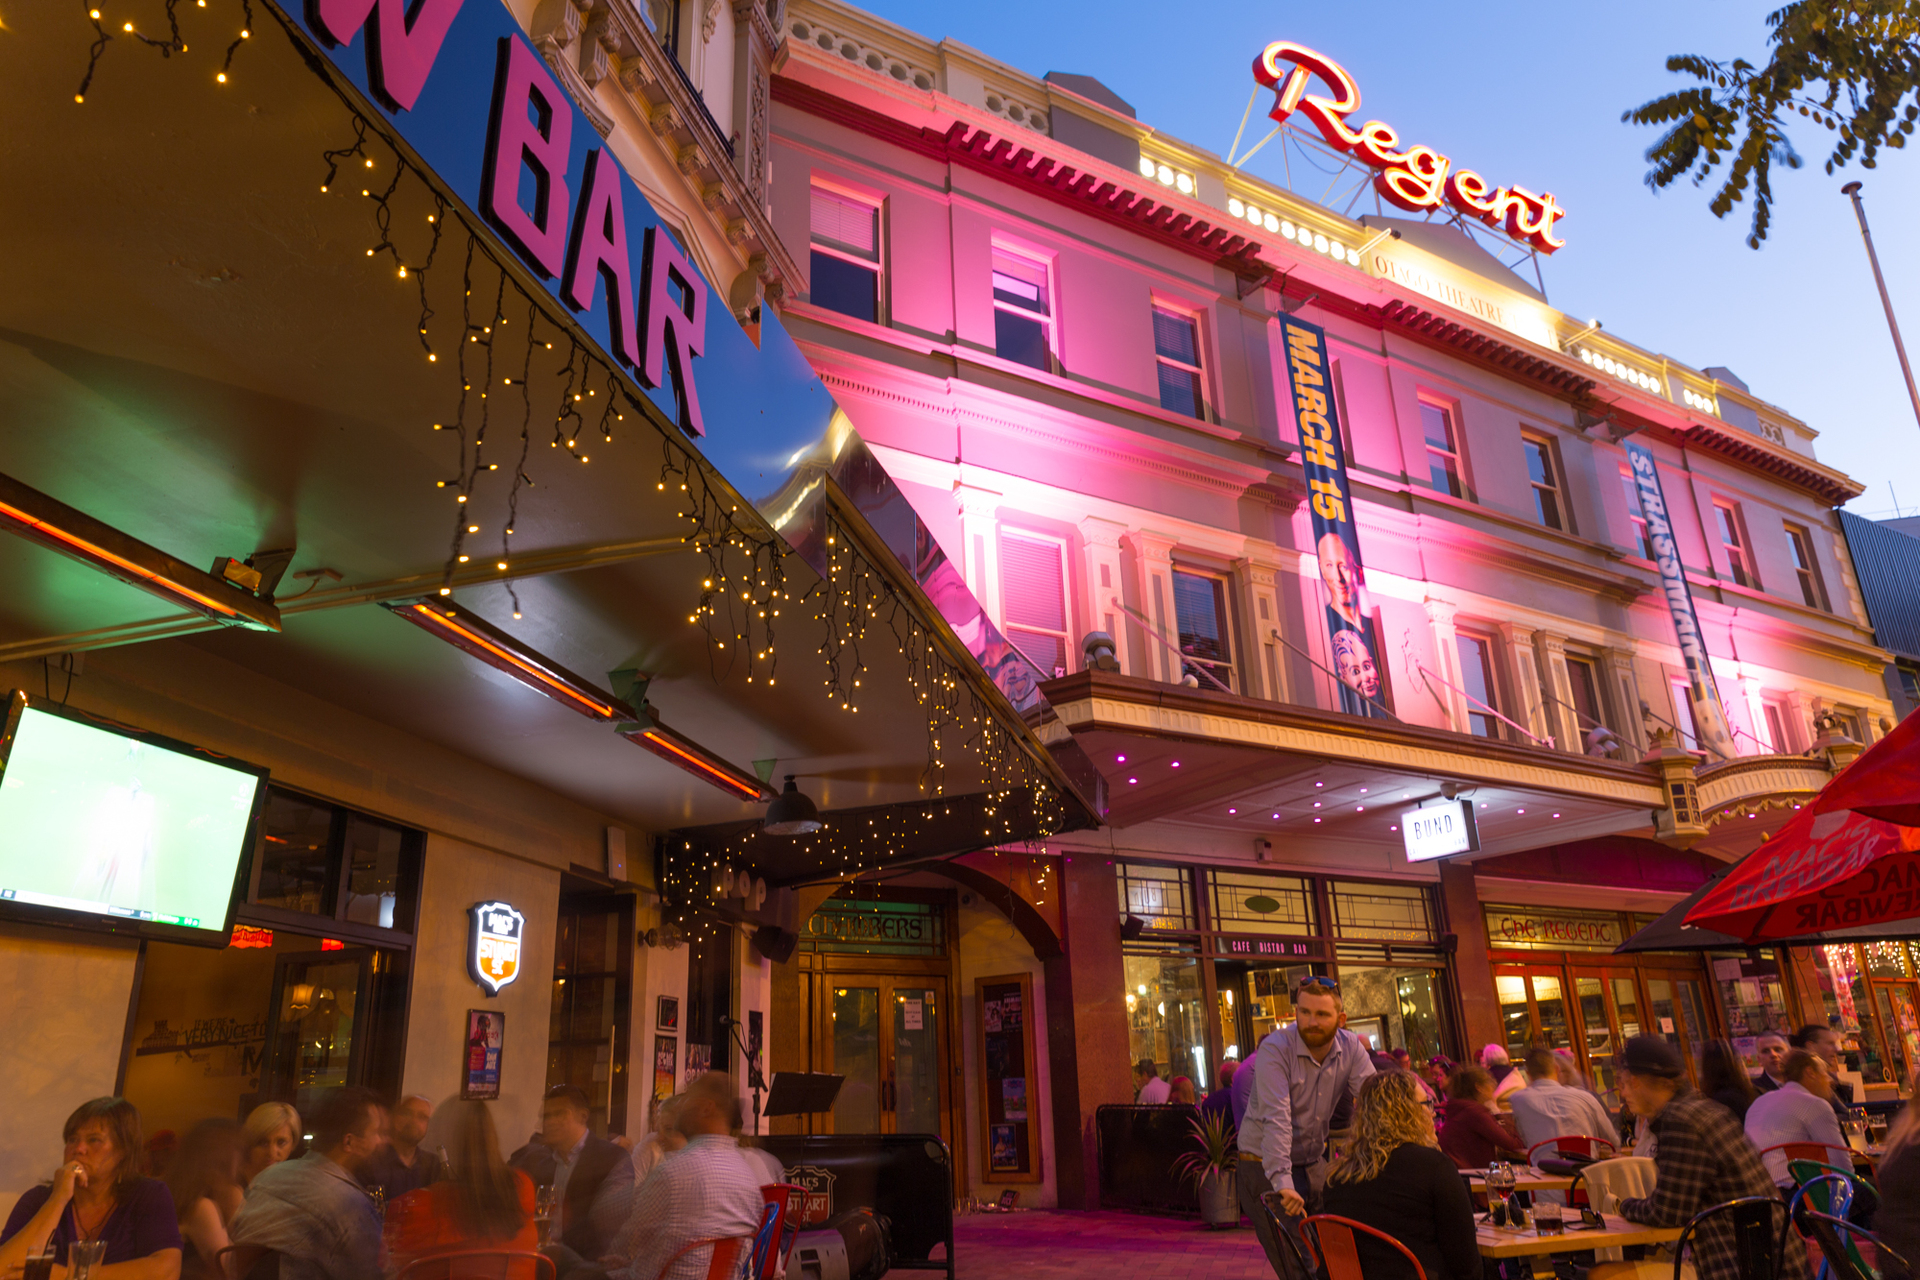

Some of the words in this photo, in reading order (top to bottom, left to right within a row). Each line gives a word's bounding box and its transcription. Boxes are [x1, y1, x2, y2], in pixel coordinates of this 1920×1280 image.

[1252, 40, 1566, 256] Regent
[479, 32, 708, 438] BAR
[1375, 255, 1431, 292] OTAGO
[1434, 280, 1507, 327] THEATRE
[1285, 322, 1338, 471] MARCH
[1310, 479, 1347, 524] 15
[1630, 450, 1704, 659] STRASSMAN
[1414, 814, 1453, 840] BUND
[1762, 817, 1873, 881] MAC'S
[1729, 834, 1880, 911] BREWBAR
[1232, 940, 1251, 952] CAFE
[1259, 942, 1285, 954] BISTRO
[1293, 943, 1307, 954] BAR
[184, 1025, 219, 1045] VERY
[791, 1177, 819, 1188] MAC'S
